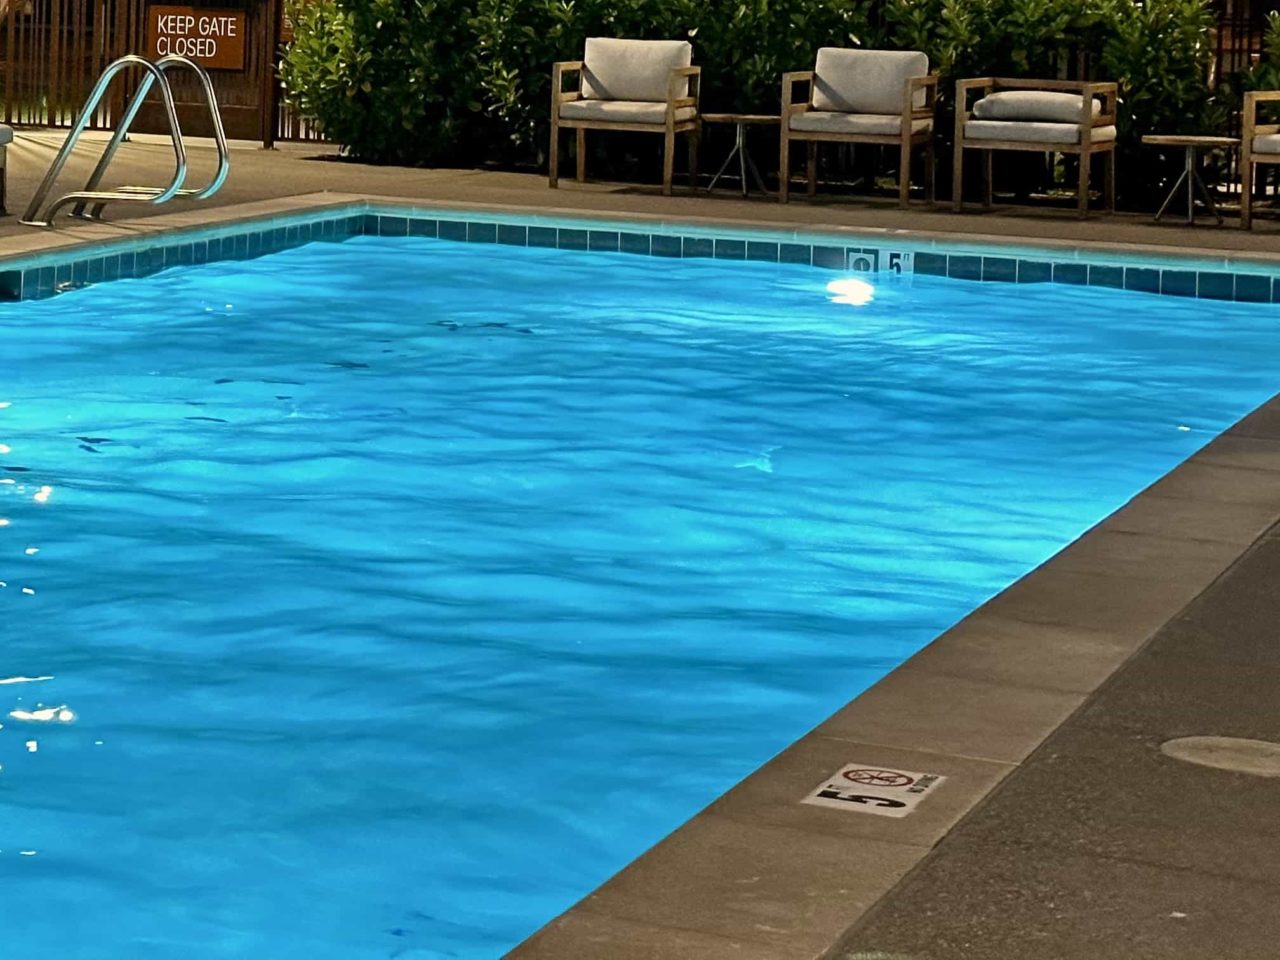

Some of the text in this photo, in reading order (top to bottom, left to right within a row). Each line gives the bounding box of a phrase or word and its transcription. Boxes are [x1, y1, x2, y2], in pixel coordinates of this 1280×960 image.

[158, 15, 237, 36] KEEP GATE
[157, 37, 217, 57] CLOSED
[889, 252, 901, 275] 5
[817, 790, 906, 808] 5
